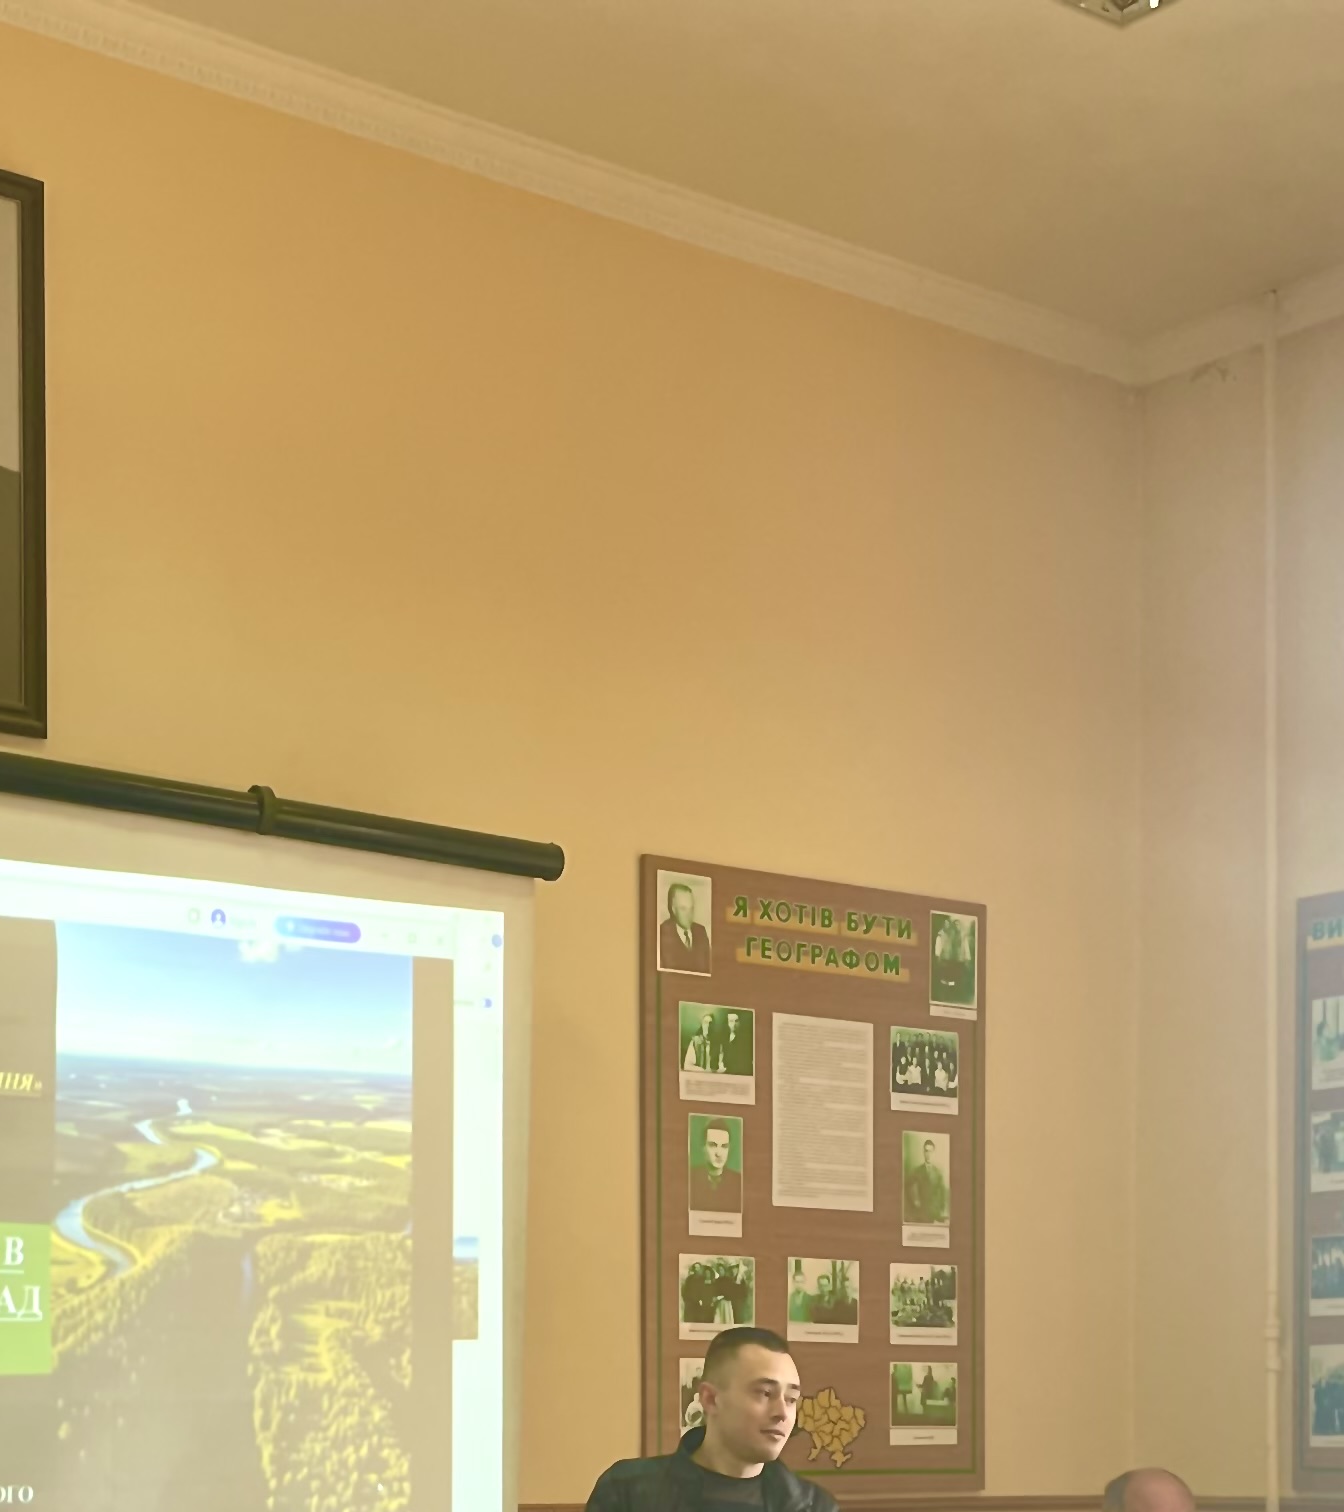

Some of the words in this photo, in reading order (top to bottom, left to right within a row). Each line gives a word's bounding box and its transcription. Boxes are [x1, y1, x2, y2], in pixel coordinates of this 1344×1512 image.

[733, 896, 748, 918] Я
[759, 899, 833, 928] ХОТІВ
[846, 911, 912, 939] БУТИ
[745, 936, 900, 975] ГЕОГРАФОМ
[4, 1235, 24, 1264] В
